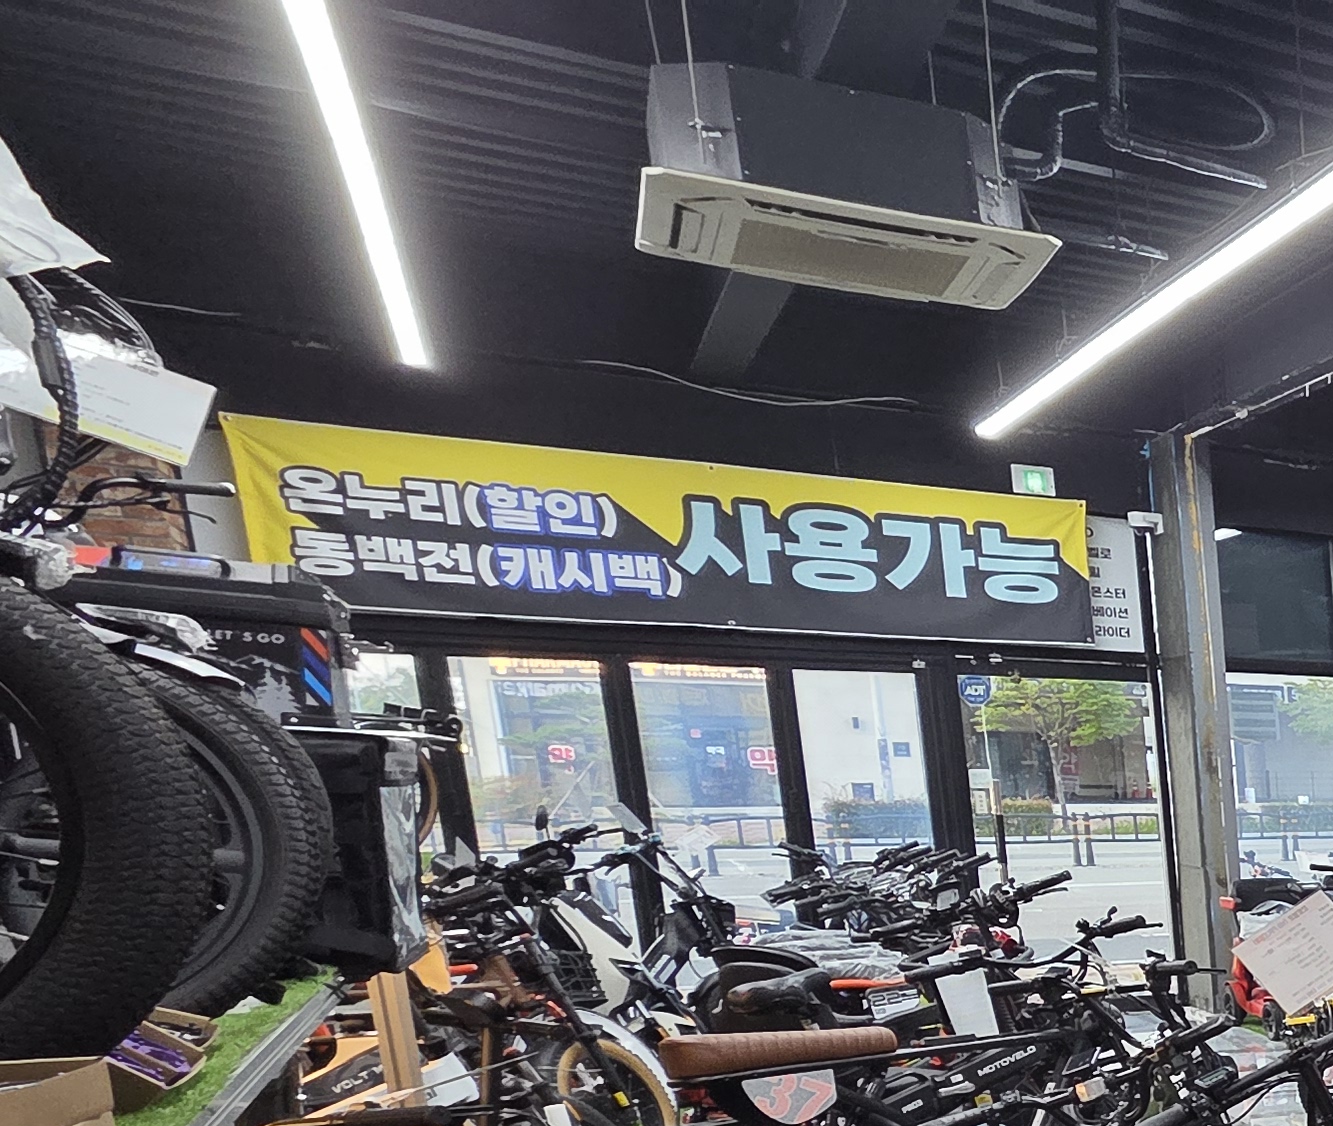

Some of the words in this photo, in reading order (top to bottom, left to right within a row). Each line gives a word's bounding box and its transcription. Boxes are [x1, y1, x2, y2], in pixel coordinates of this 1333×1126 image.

[282, 468, 617, 538] 온누리(할인)
[295, 528, 682, 598] 동백전(캐시백)
[676, 499, 1059, 604] 사용가능
[257, 632, 286, 644] GO
[964, 684, 986, 696] ADT
[977, 1045, 1037, 1078] MOTOVELO
[331, 1071, 369, 1095] VOLT
[755, 1074, 834, 1123] 37
